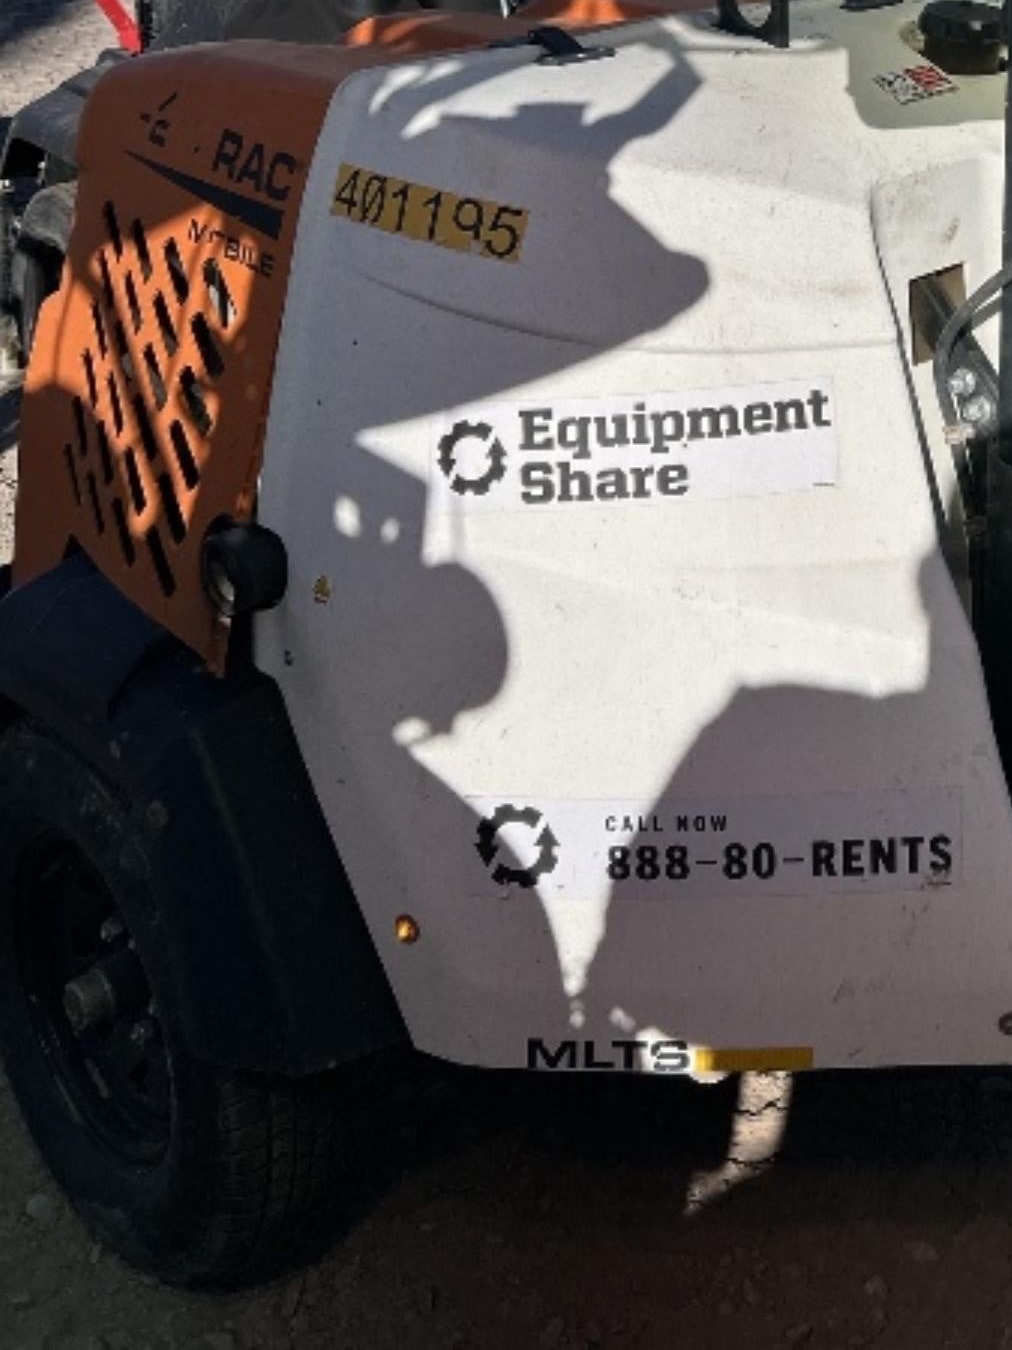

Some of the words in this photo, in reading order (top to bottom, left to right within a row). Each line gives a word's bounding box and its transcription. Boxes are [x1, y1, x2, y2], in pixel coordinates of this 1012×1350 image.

[334, 168, 523, 259] 401195
[518, 389, 832, 460] Equipment
[520, 461, 690, 505] Share
[604, 815, 664, 833] CALL
[676, 815, 729, 833] NOW
[606, 834, 953, 881] 888-80-RENTS
[527, 1038, 691, 1072] MLTS
